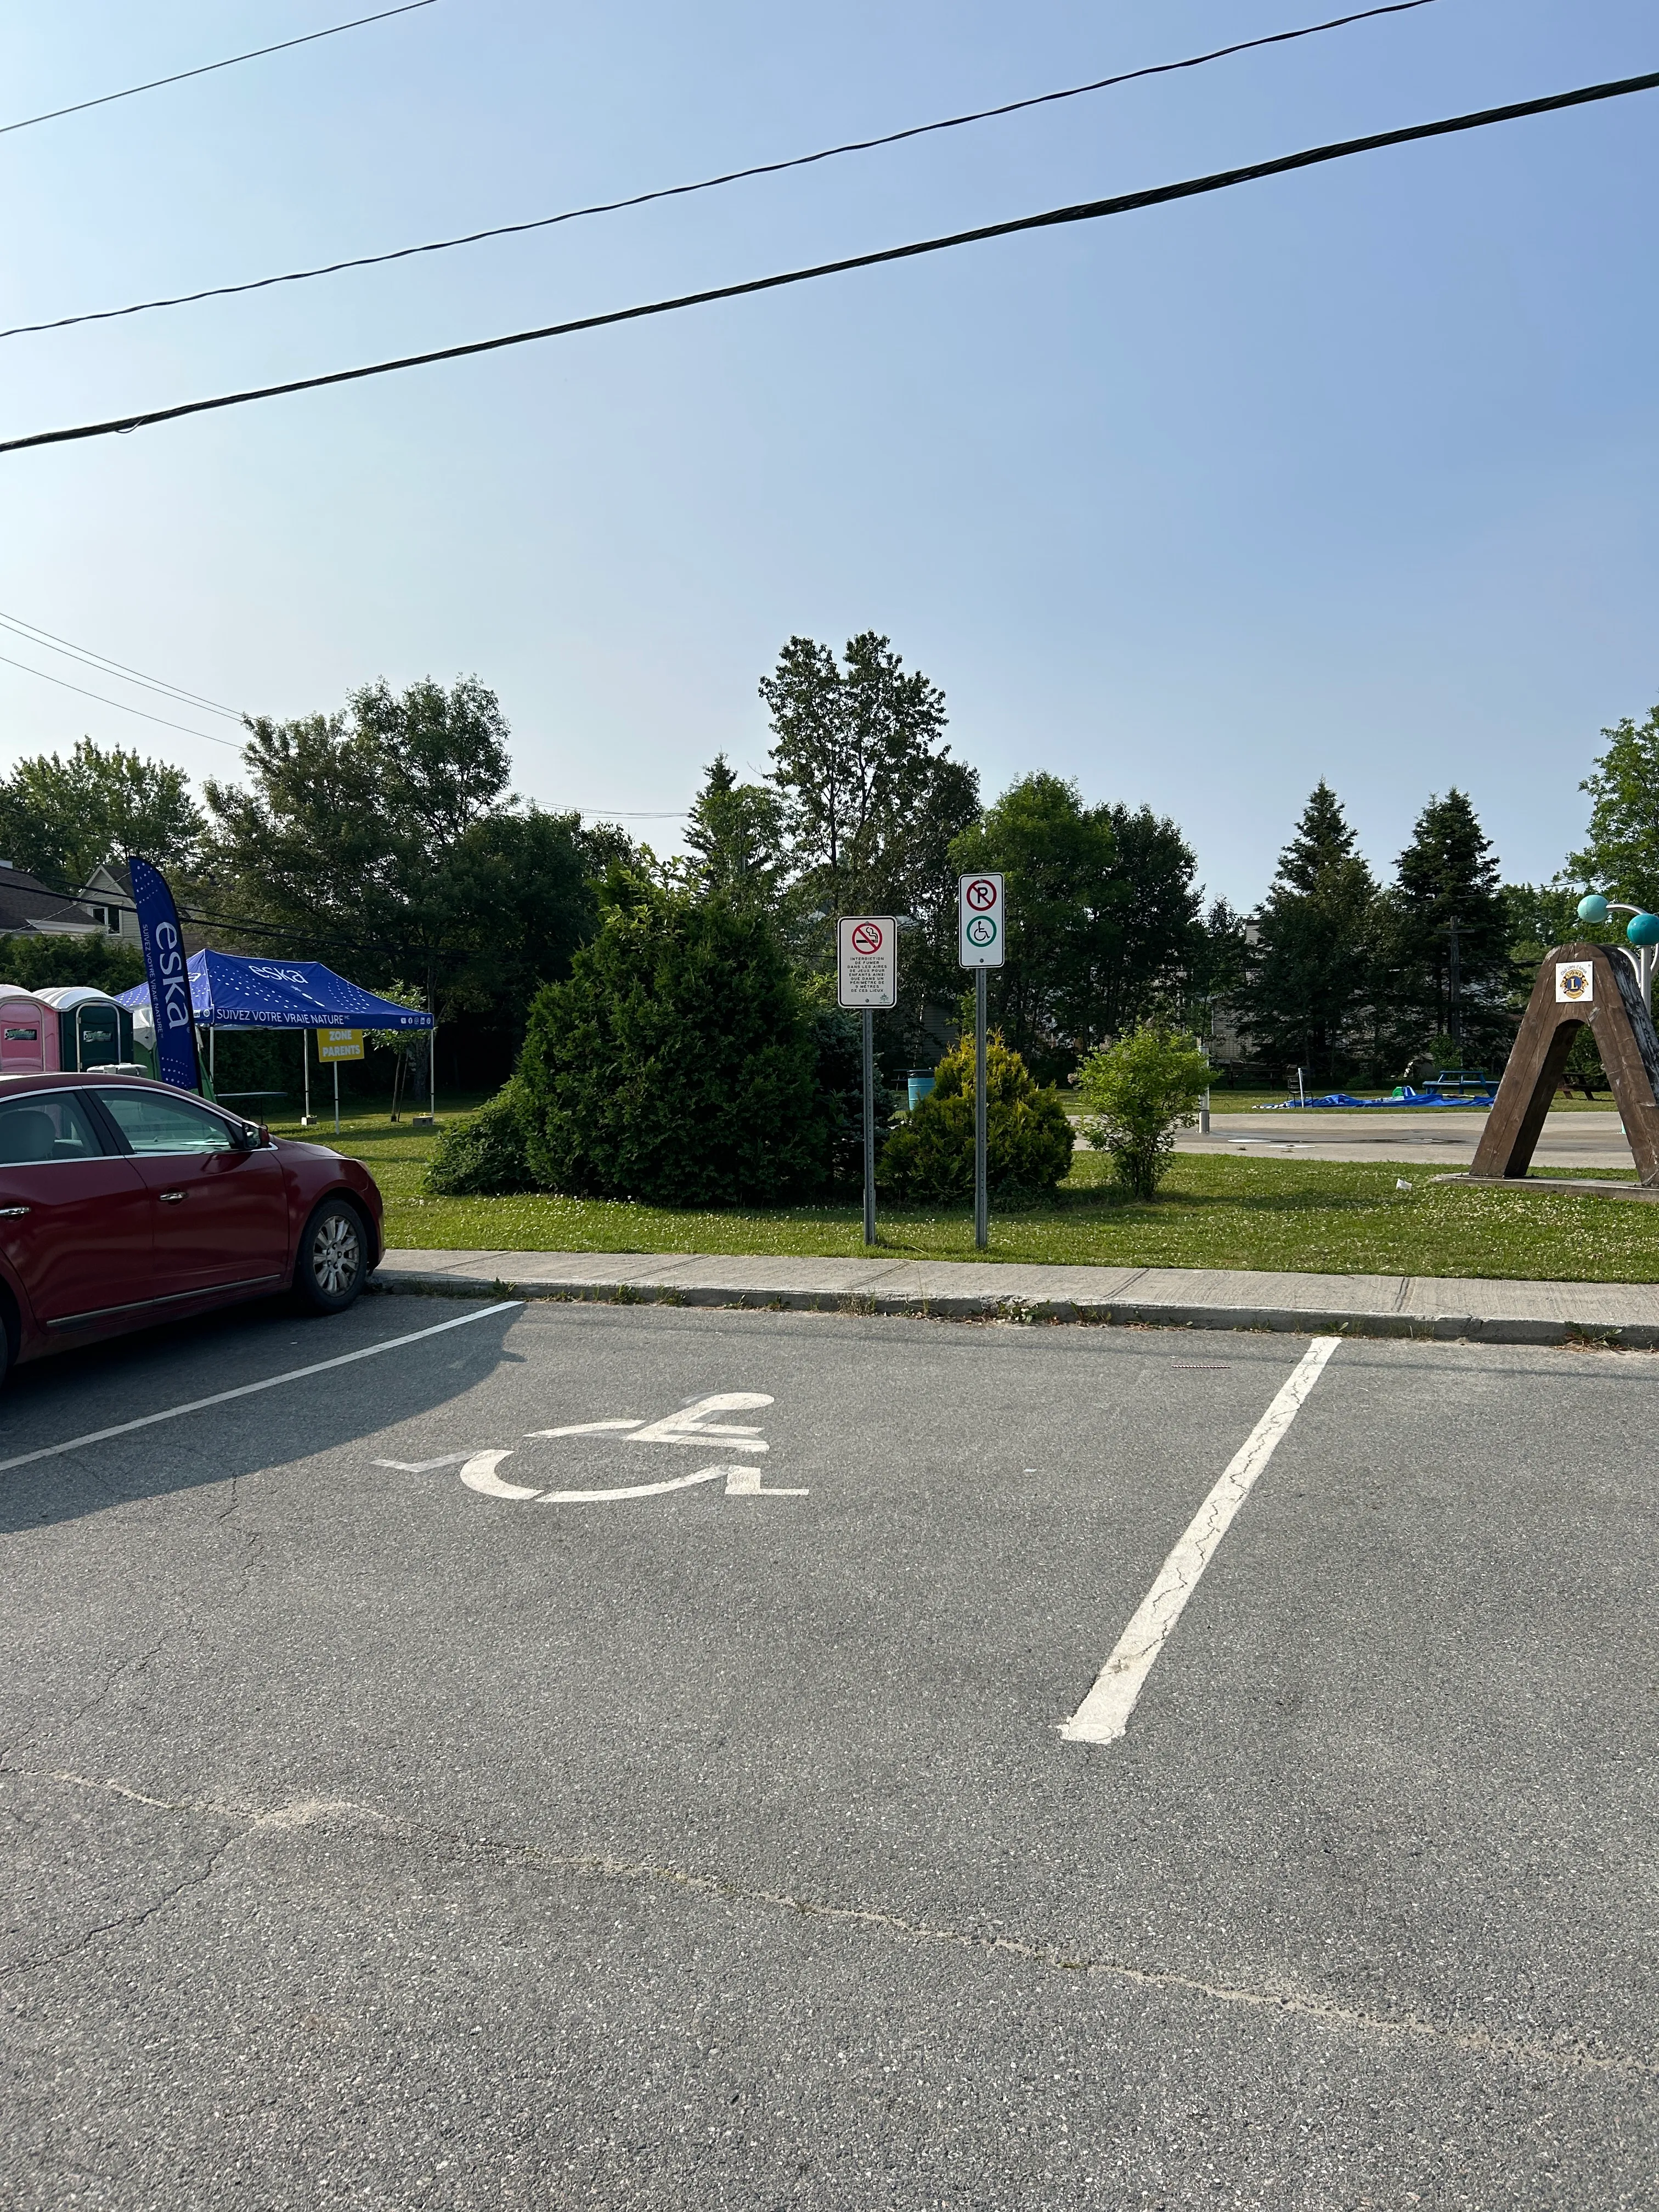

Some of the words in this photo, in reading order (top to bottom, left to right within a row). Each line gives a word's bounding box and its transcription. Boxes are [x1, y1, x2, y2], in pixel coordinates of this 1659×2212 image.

[977, 887, 988, 904] P
[143, 924, 151, 951] SUIVEZ
[146, 952, 156, 978] VOTRE
[156, 922, 189, 1029] eska
[249, 966, 308, 984] eska
[1570, 978, 1578, 989] L
[216, 1009, 250, 1020] SUIVEZ
[251, 1011, 283, 1022] VOTRE
[283, 1013, 310, 1024] VRAIE
[310, 1014, 345, 1025] NATURE
[329, 1030, 352, 1041] ZONE
[322, 1045, 360, 1057] PARENTS
